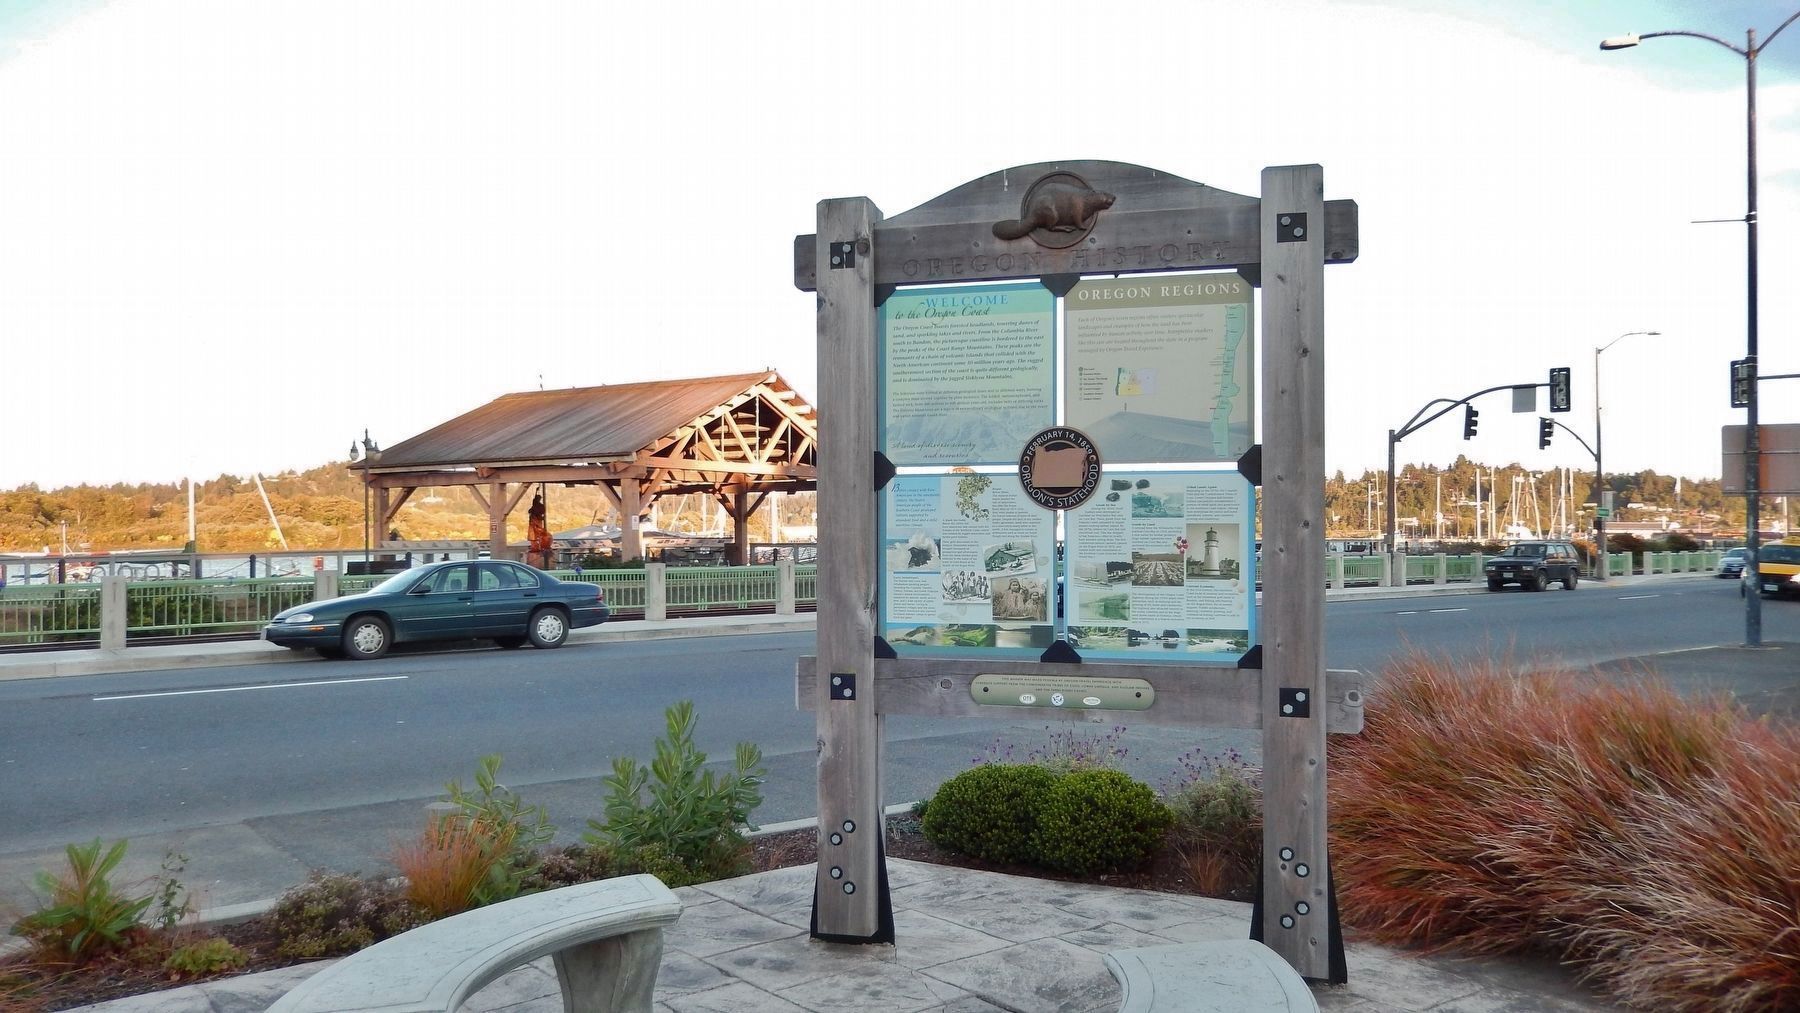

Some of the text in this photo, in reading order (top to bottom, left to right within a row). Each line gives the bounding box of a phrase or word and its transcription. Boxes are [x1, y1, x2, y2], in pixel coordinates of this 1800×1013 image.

[903, 241, 1230, 277] OREGON HISTORY
[926, 294, 1008, 308] WELCOME
[1078, 282, 1240, 300] OREGON REGIONS
[894, 306, 990, 321] to the Oregon Coast
[1027, 430, 1093, 456] FEBRUARY 14, 1859
[1022, 464, 1098, 507] OREGON'S STATEHOOD
